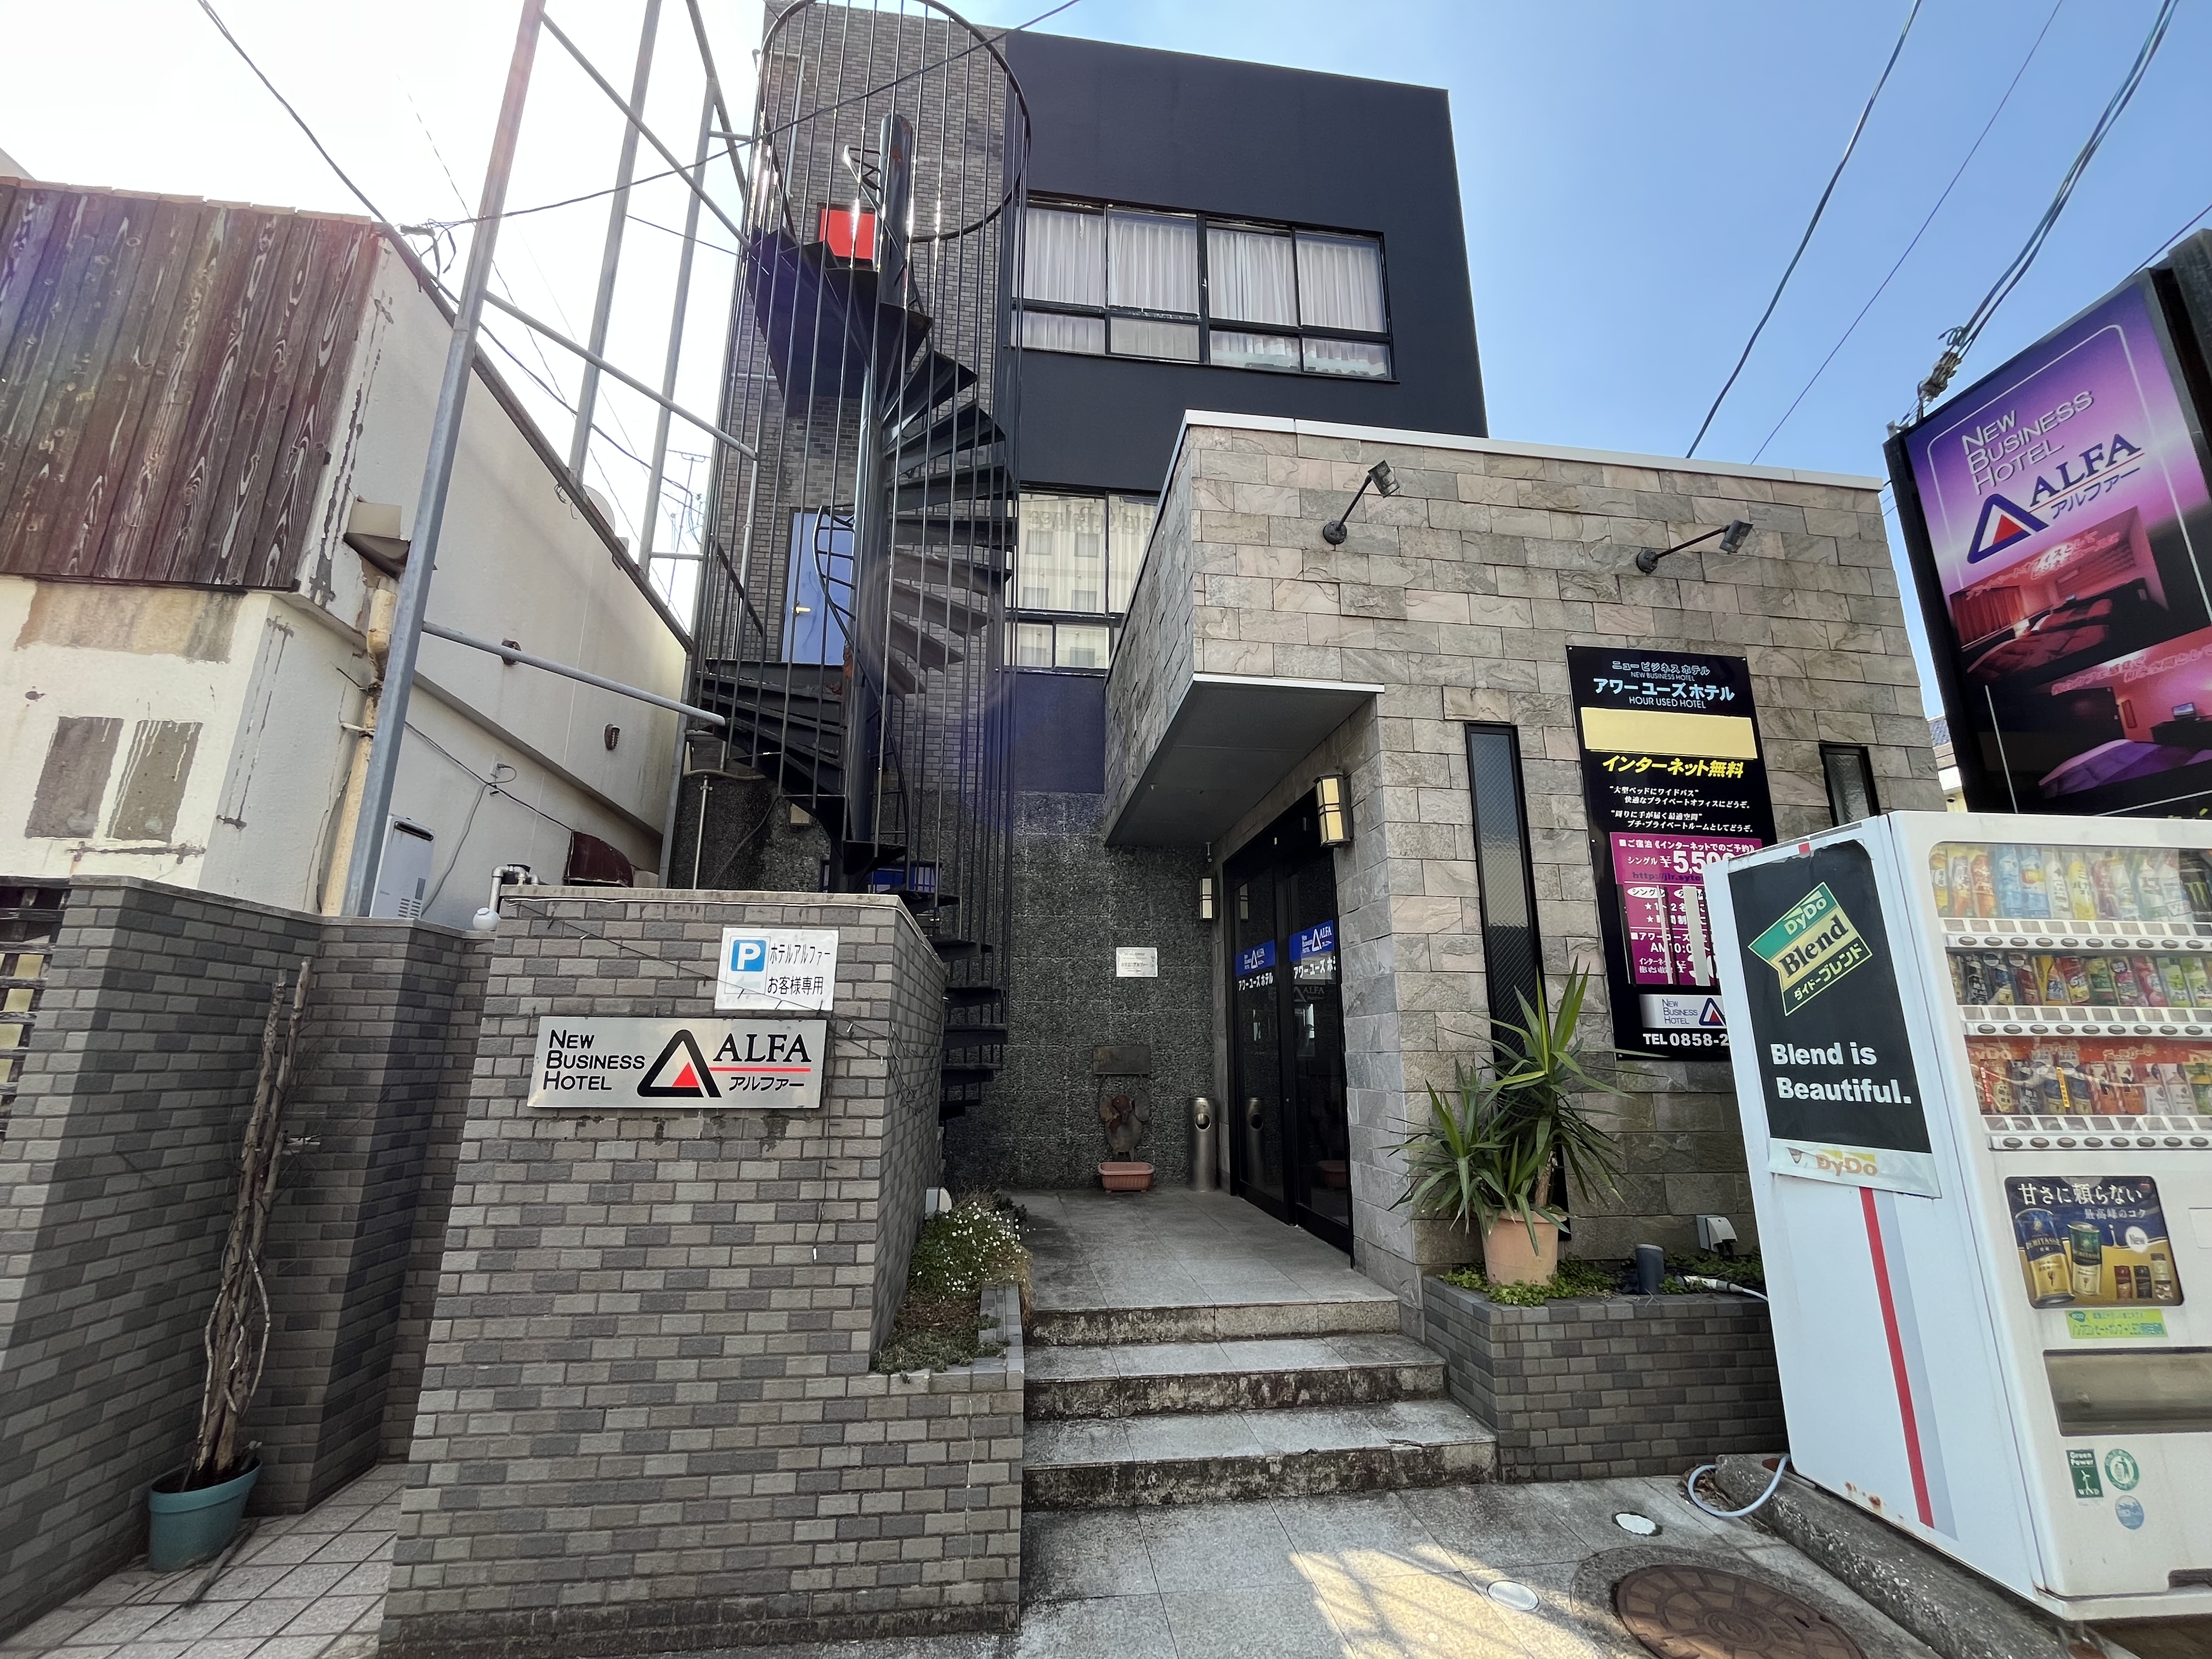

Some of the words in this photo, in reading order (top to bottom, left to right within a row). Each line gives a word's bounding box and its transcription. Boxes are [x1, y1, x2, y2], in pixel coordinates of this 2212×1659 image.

[1968, 391, 2093, 476] BUSINESS
[1973, 441, 2064, 495] HOTEL
[2030, 434, 2141, 506] ALFA
[2051, 467, 2140, 520] アルファー
[1629, 696, 1654, 706] HOUR
[1656, 698, 1678, 707] USED
[1680, 699, 1706, 708] HOTEL
[1602, 755, 1743, 778] インターネット無料
[1628, 856, 1658, 865] シングル
[1784, 895, 1827, 936] DyDo
[737, 943, 761, 969] P
[770, 943, 831, 966] ホテルアルファー
[1778, 915, 1848, 978] Blend
[1793, 944, 1863, 1001] ダイドーブレンド
[767, 976, 824, 995] お客様専用
[1664, 1016, 1689, 1024] HOTEL
[550, 1030, 595, 1049] NEW
[713, 1033, 811, 1063] ALFA
[1643, 1034, 1667, 1045] TEL
[547, 1051, 645, 1070] BUSINESS
[1770, 1042, 1843, 1065] Blend
[1850, 1042, 1877, 1065] is
[543, 1071, 612, 1091] HOTEL
[729, 1076, 804, 1092] アルファー
[1776, 1077, 1911, 1104] Beautiful.
[1816, 1154, 1877, 1176] DyDo
[2018, 1183, 2143, 1205] 甘さに頼らない
